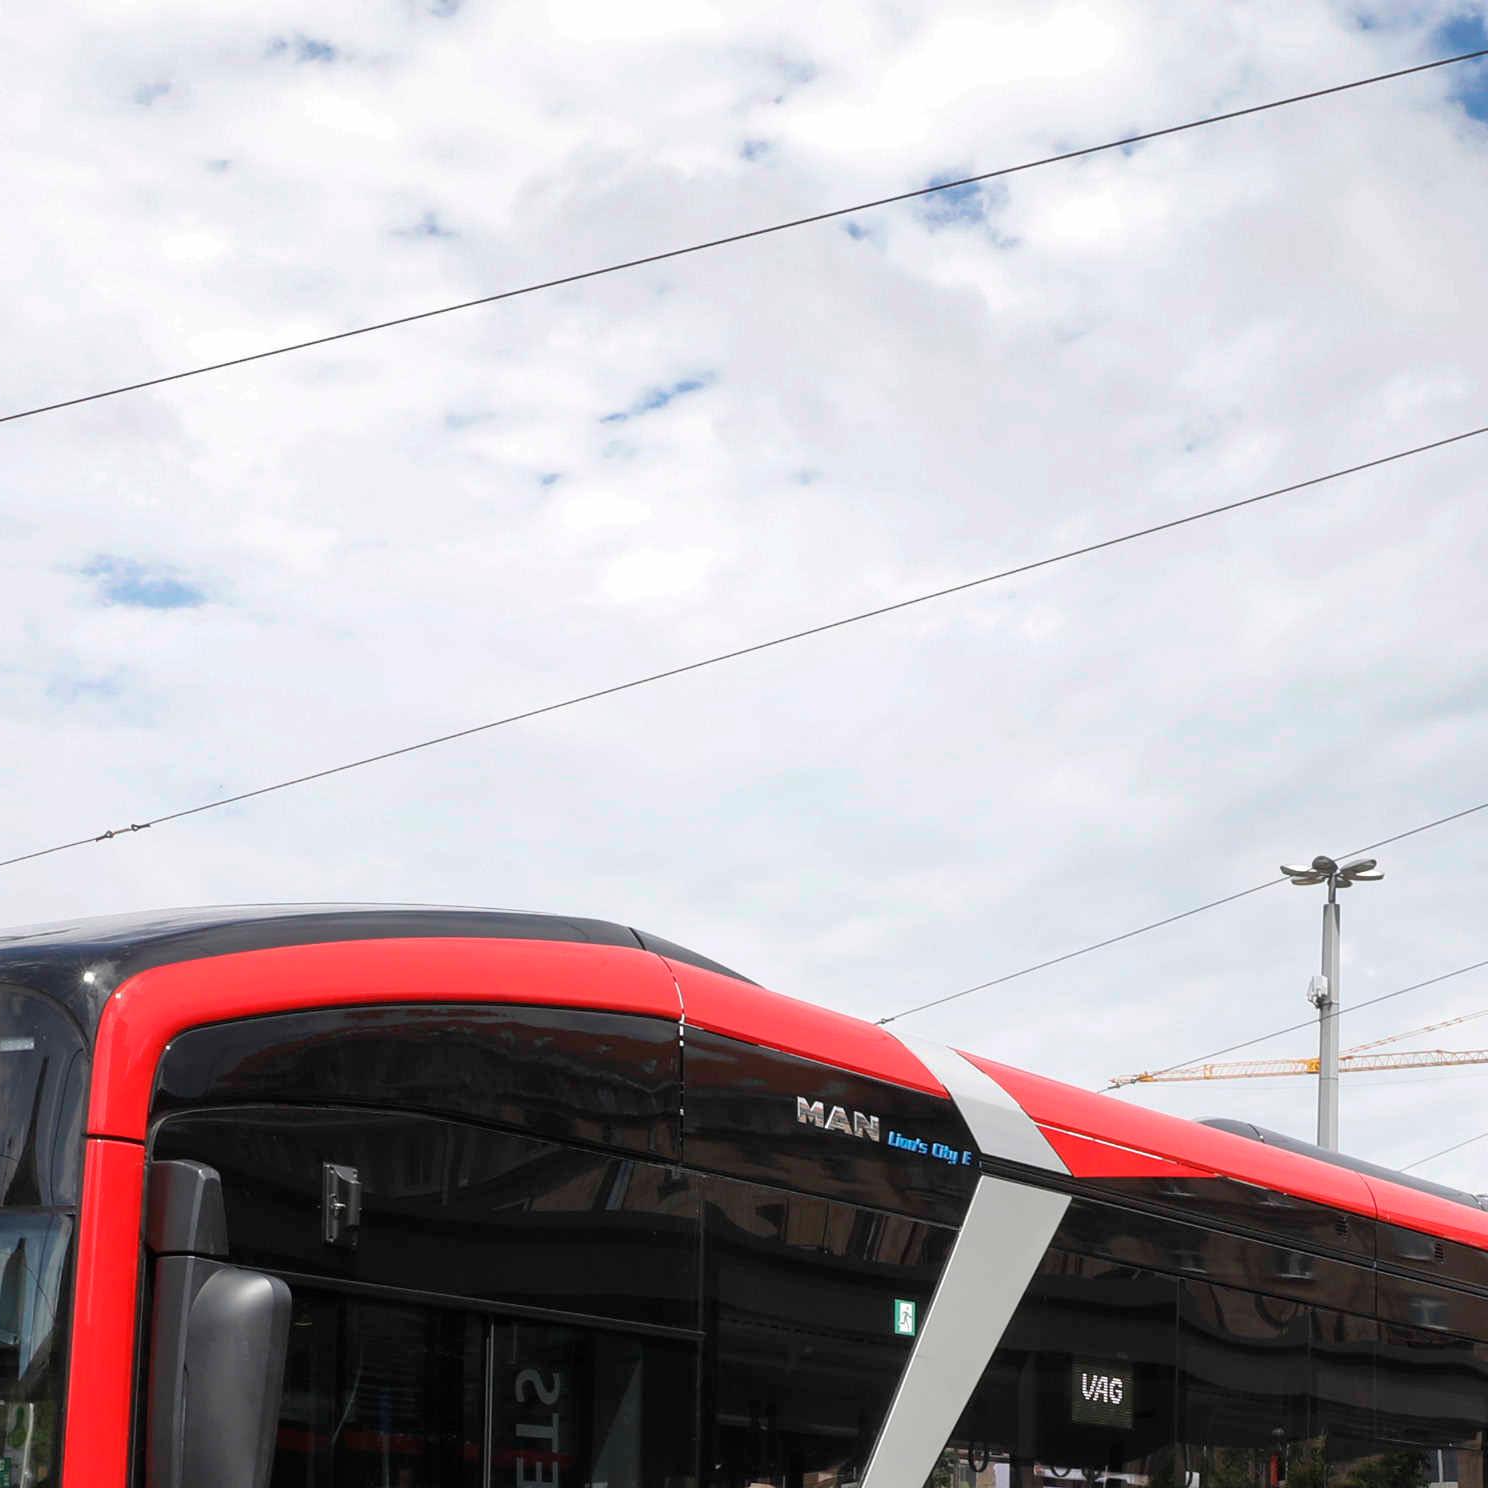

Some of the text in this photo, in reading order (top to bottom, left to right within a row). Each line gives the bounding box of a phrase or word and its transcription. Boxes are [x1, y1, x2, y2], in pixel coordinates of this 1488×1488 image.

[797, 1096, 974, 1166] MAN Lion's City E
[1082, 1373, 1123, 1405] VAG
